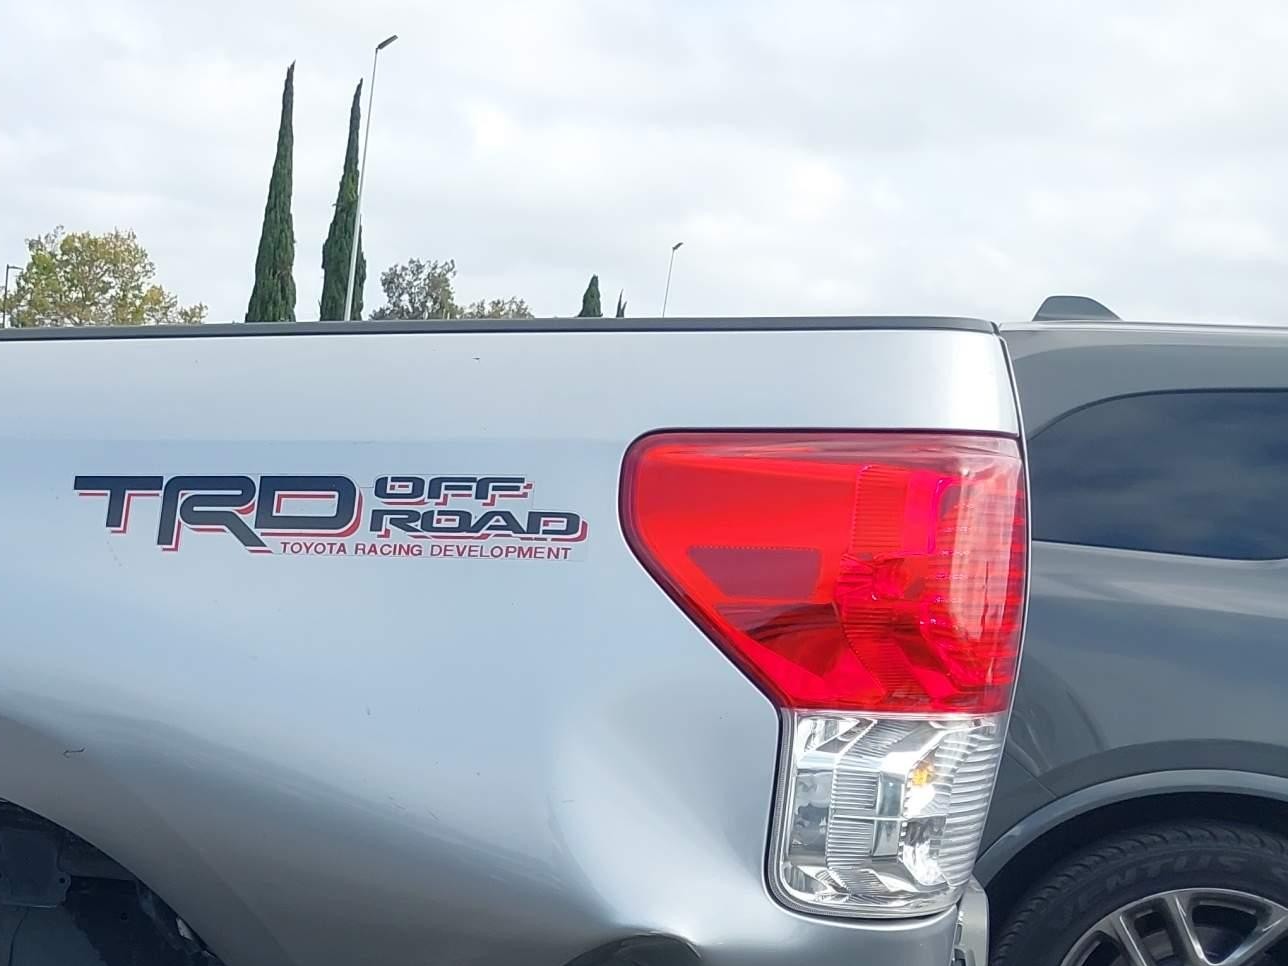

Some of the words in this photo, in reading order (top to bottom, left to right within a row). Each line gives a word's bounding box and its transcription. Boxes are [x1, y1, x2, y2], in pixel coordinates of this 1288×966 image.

[373, 475, 534, 506] OFF
[73, 475, 364, 553] TRD
[369, 509, 589, 542] ROAD
[280, 541, 346, 555] TOYOTA
[354, 543, 423, 557] RACING
[430, 545, 572, 560] DEVELOPMENT
